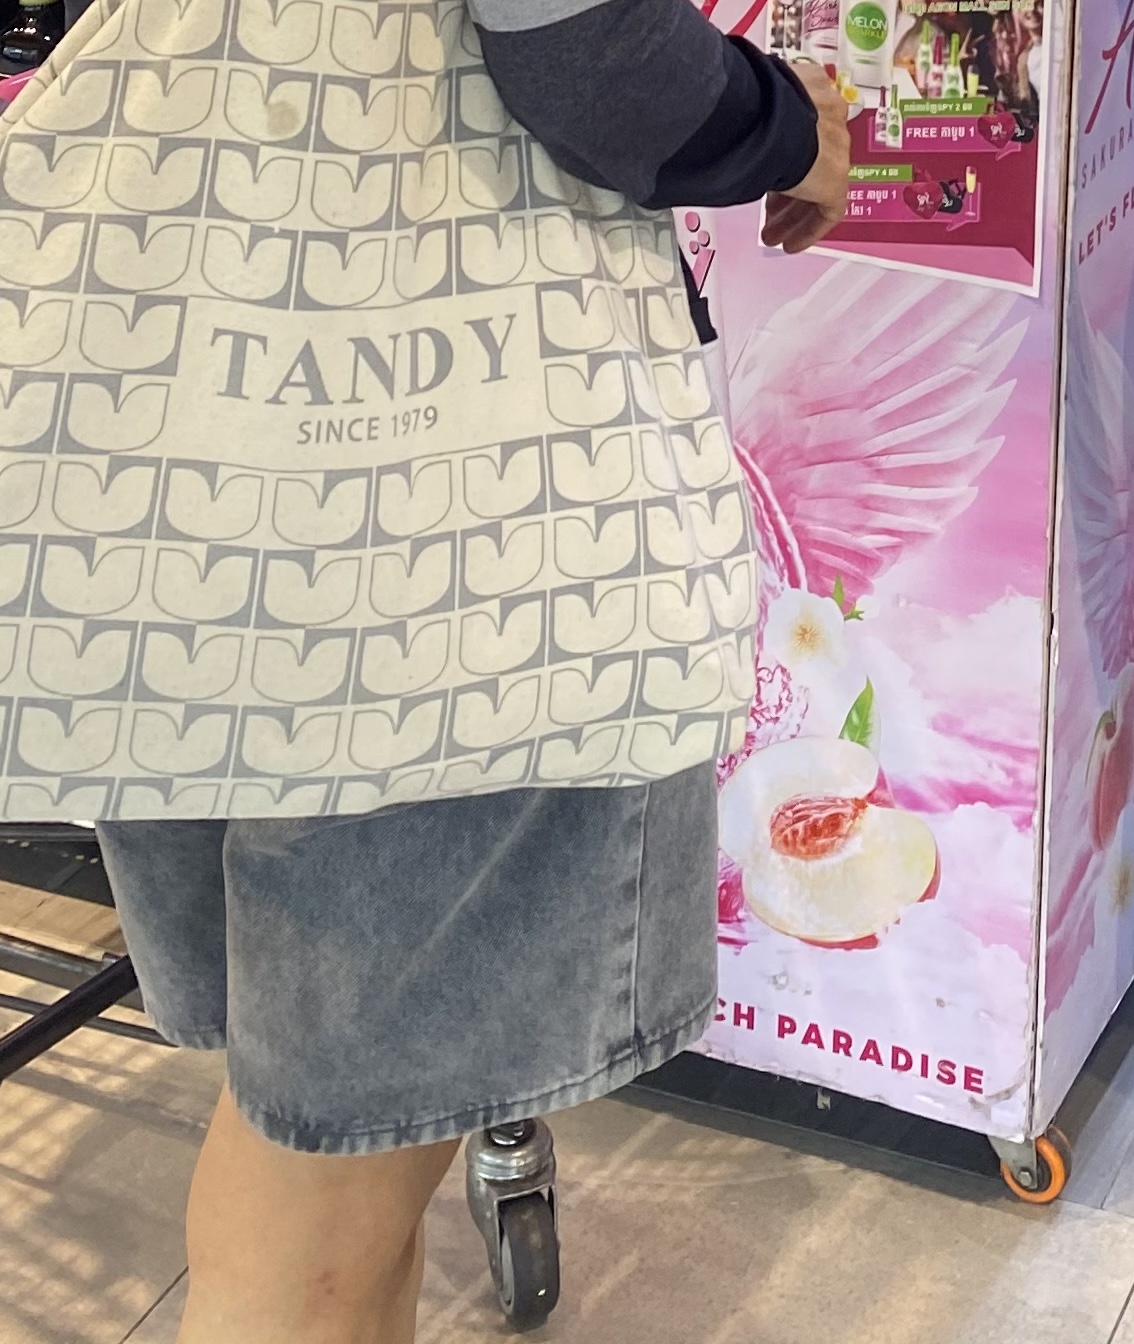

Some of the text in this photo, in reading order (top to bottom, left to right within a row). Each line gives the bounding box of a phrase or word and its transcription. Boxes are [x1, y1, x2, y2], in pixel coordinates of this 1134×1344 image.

[847, 15, 887, 30] MELON
[906, 127, 937, 138] FREE
[969, 127, 975, 137] 1
[1080, 118, 1134, 189] SAKURA
[891, 189, 897, 200] 1
[1078, 207, 1116, 267] LET'S
[211, 313, 517, 406] TANDY
[297, 405, 438, 445] SINCE 1979
[777, 1014, 984, 1094] PARADISE
